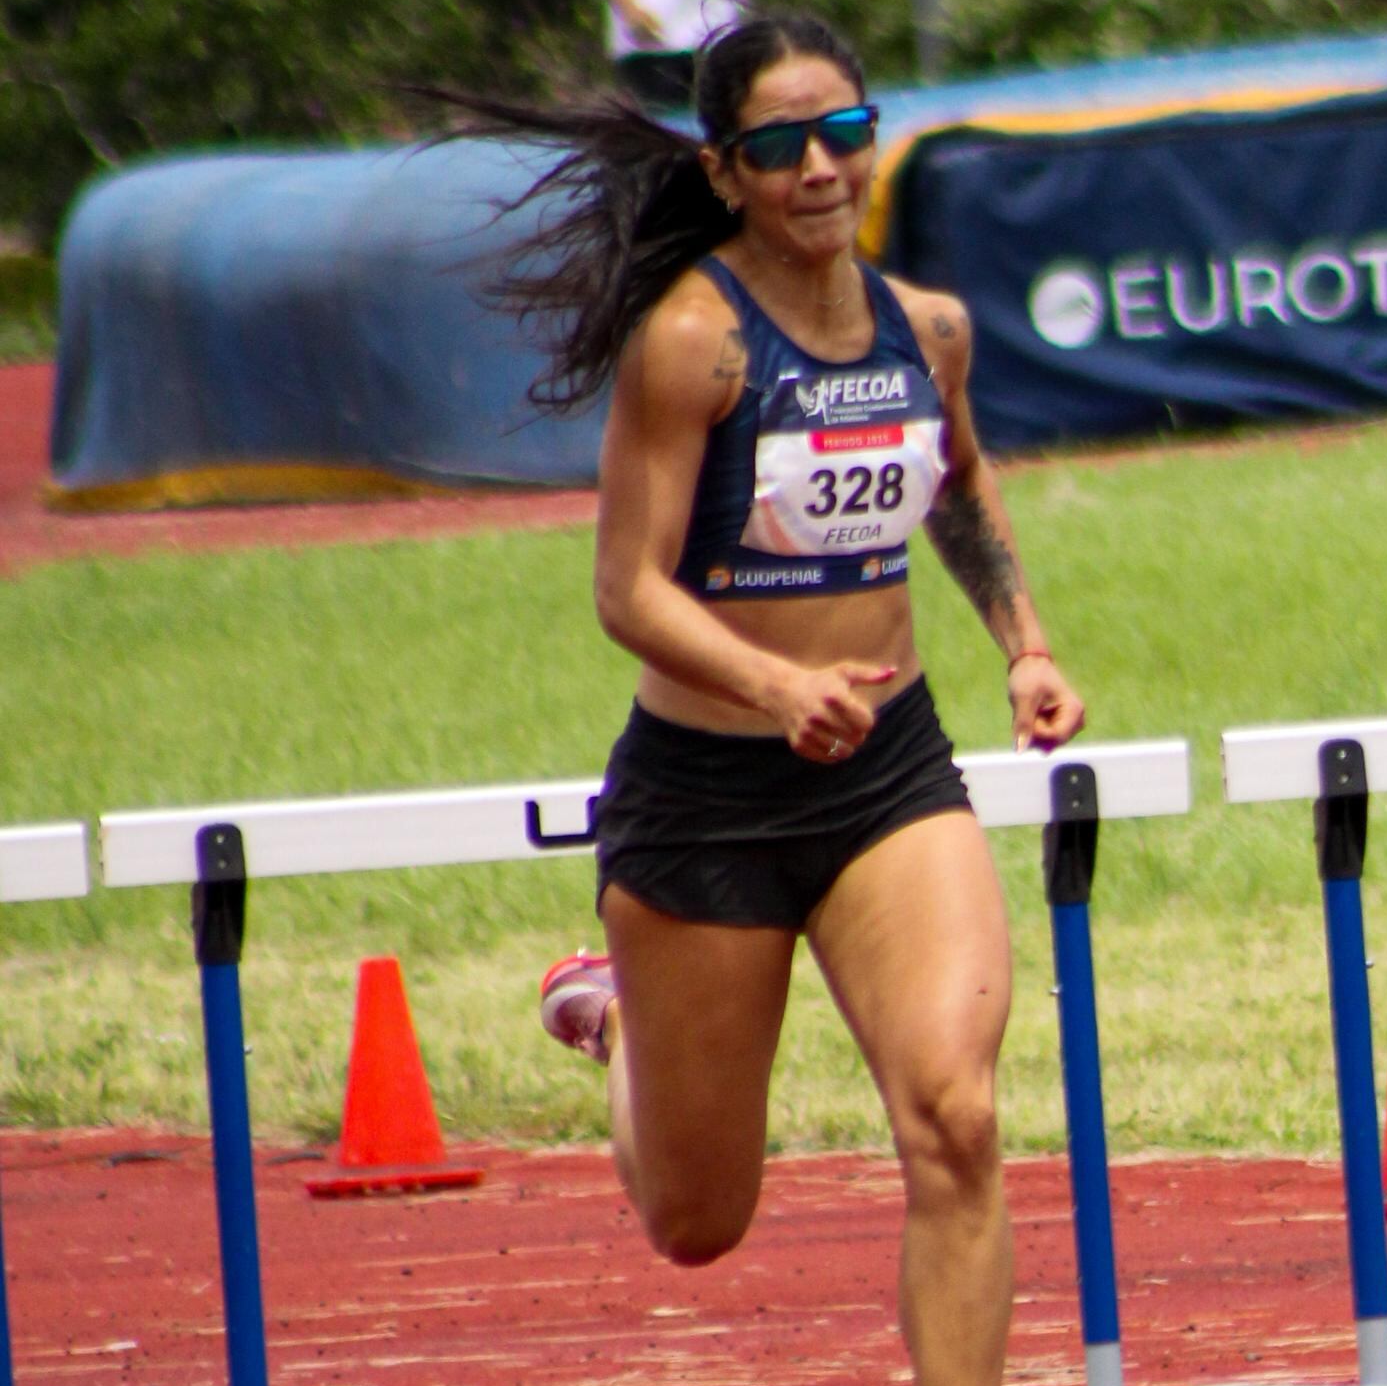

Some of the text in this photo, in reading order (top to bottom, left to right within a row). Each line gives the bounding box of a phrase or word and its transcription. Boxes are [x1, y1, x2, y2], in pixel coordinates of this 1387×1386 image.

[829, 371, 906, 404] FECOA
[803, 462, 905, 519] 328
[822, 524, 882, 545] FECOA
[734, 567, 824, 587] COOPENAE
